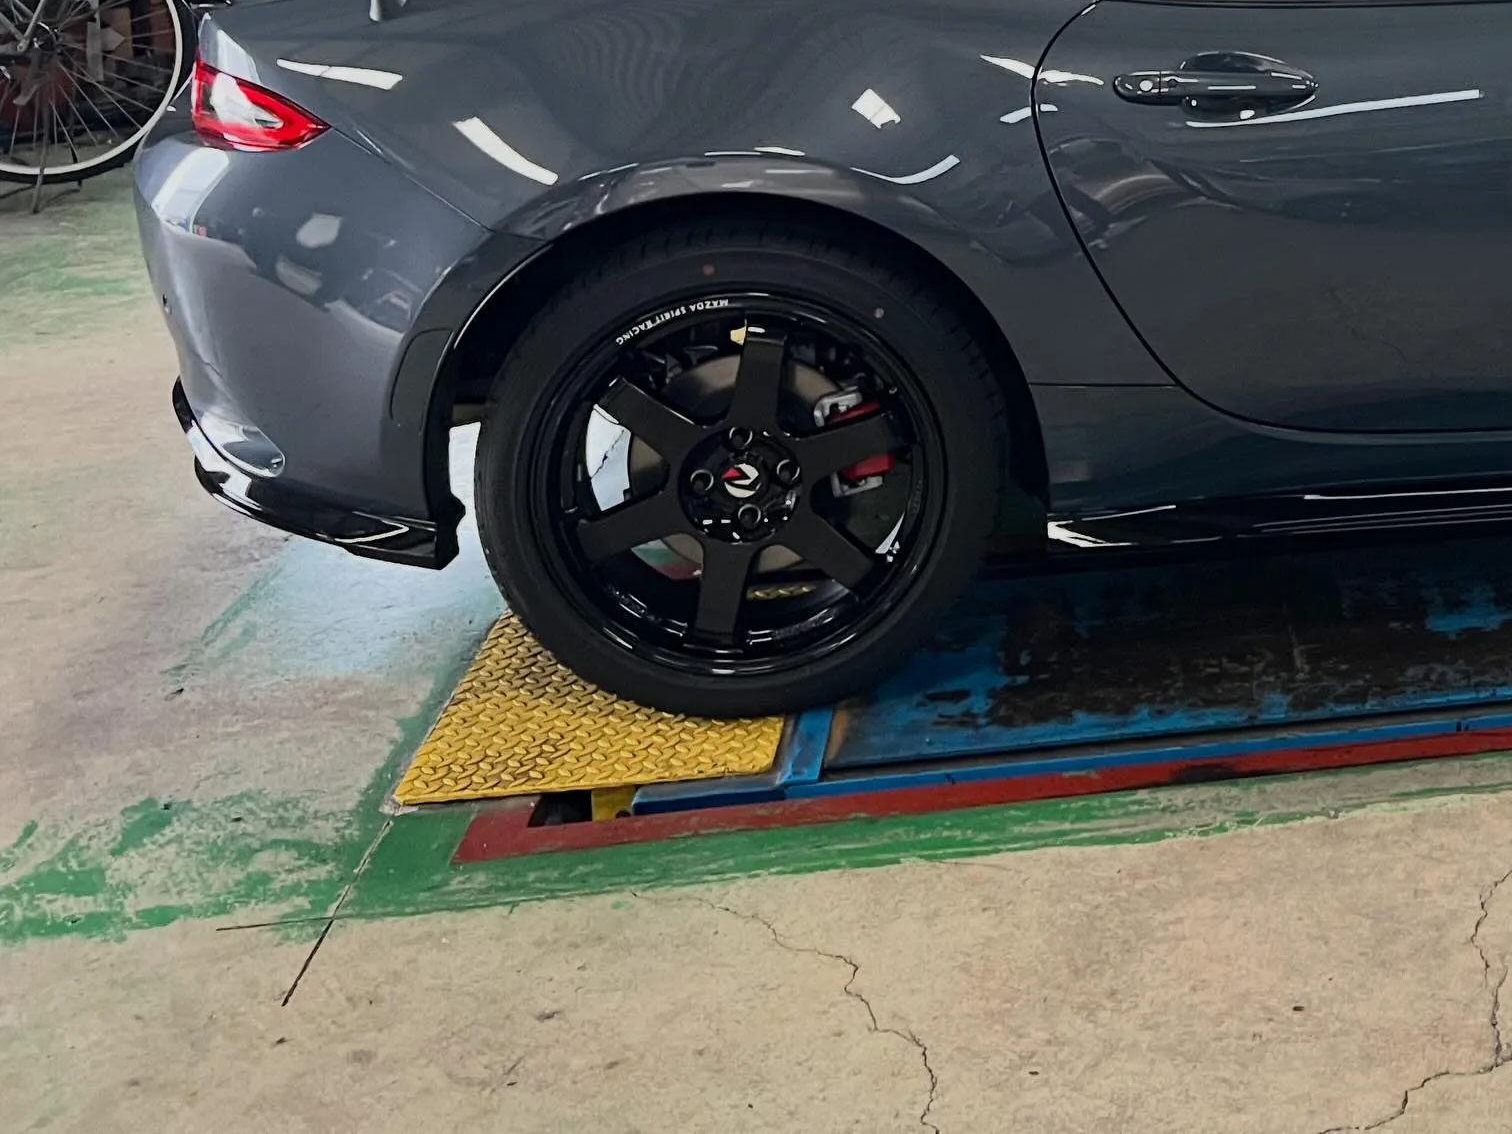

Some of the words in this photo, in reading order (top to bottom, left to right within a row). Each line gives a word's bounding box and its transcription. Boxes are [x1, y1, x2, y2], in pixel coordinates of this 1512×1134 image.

[689, 299, 729, 312] MAZDA
[655, 306, 687, 324] SPIRIT
[615, 319, 655, 346] RACING
